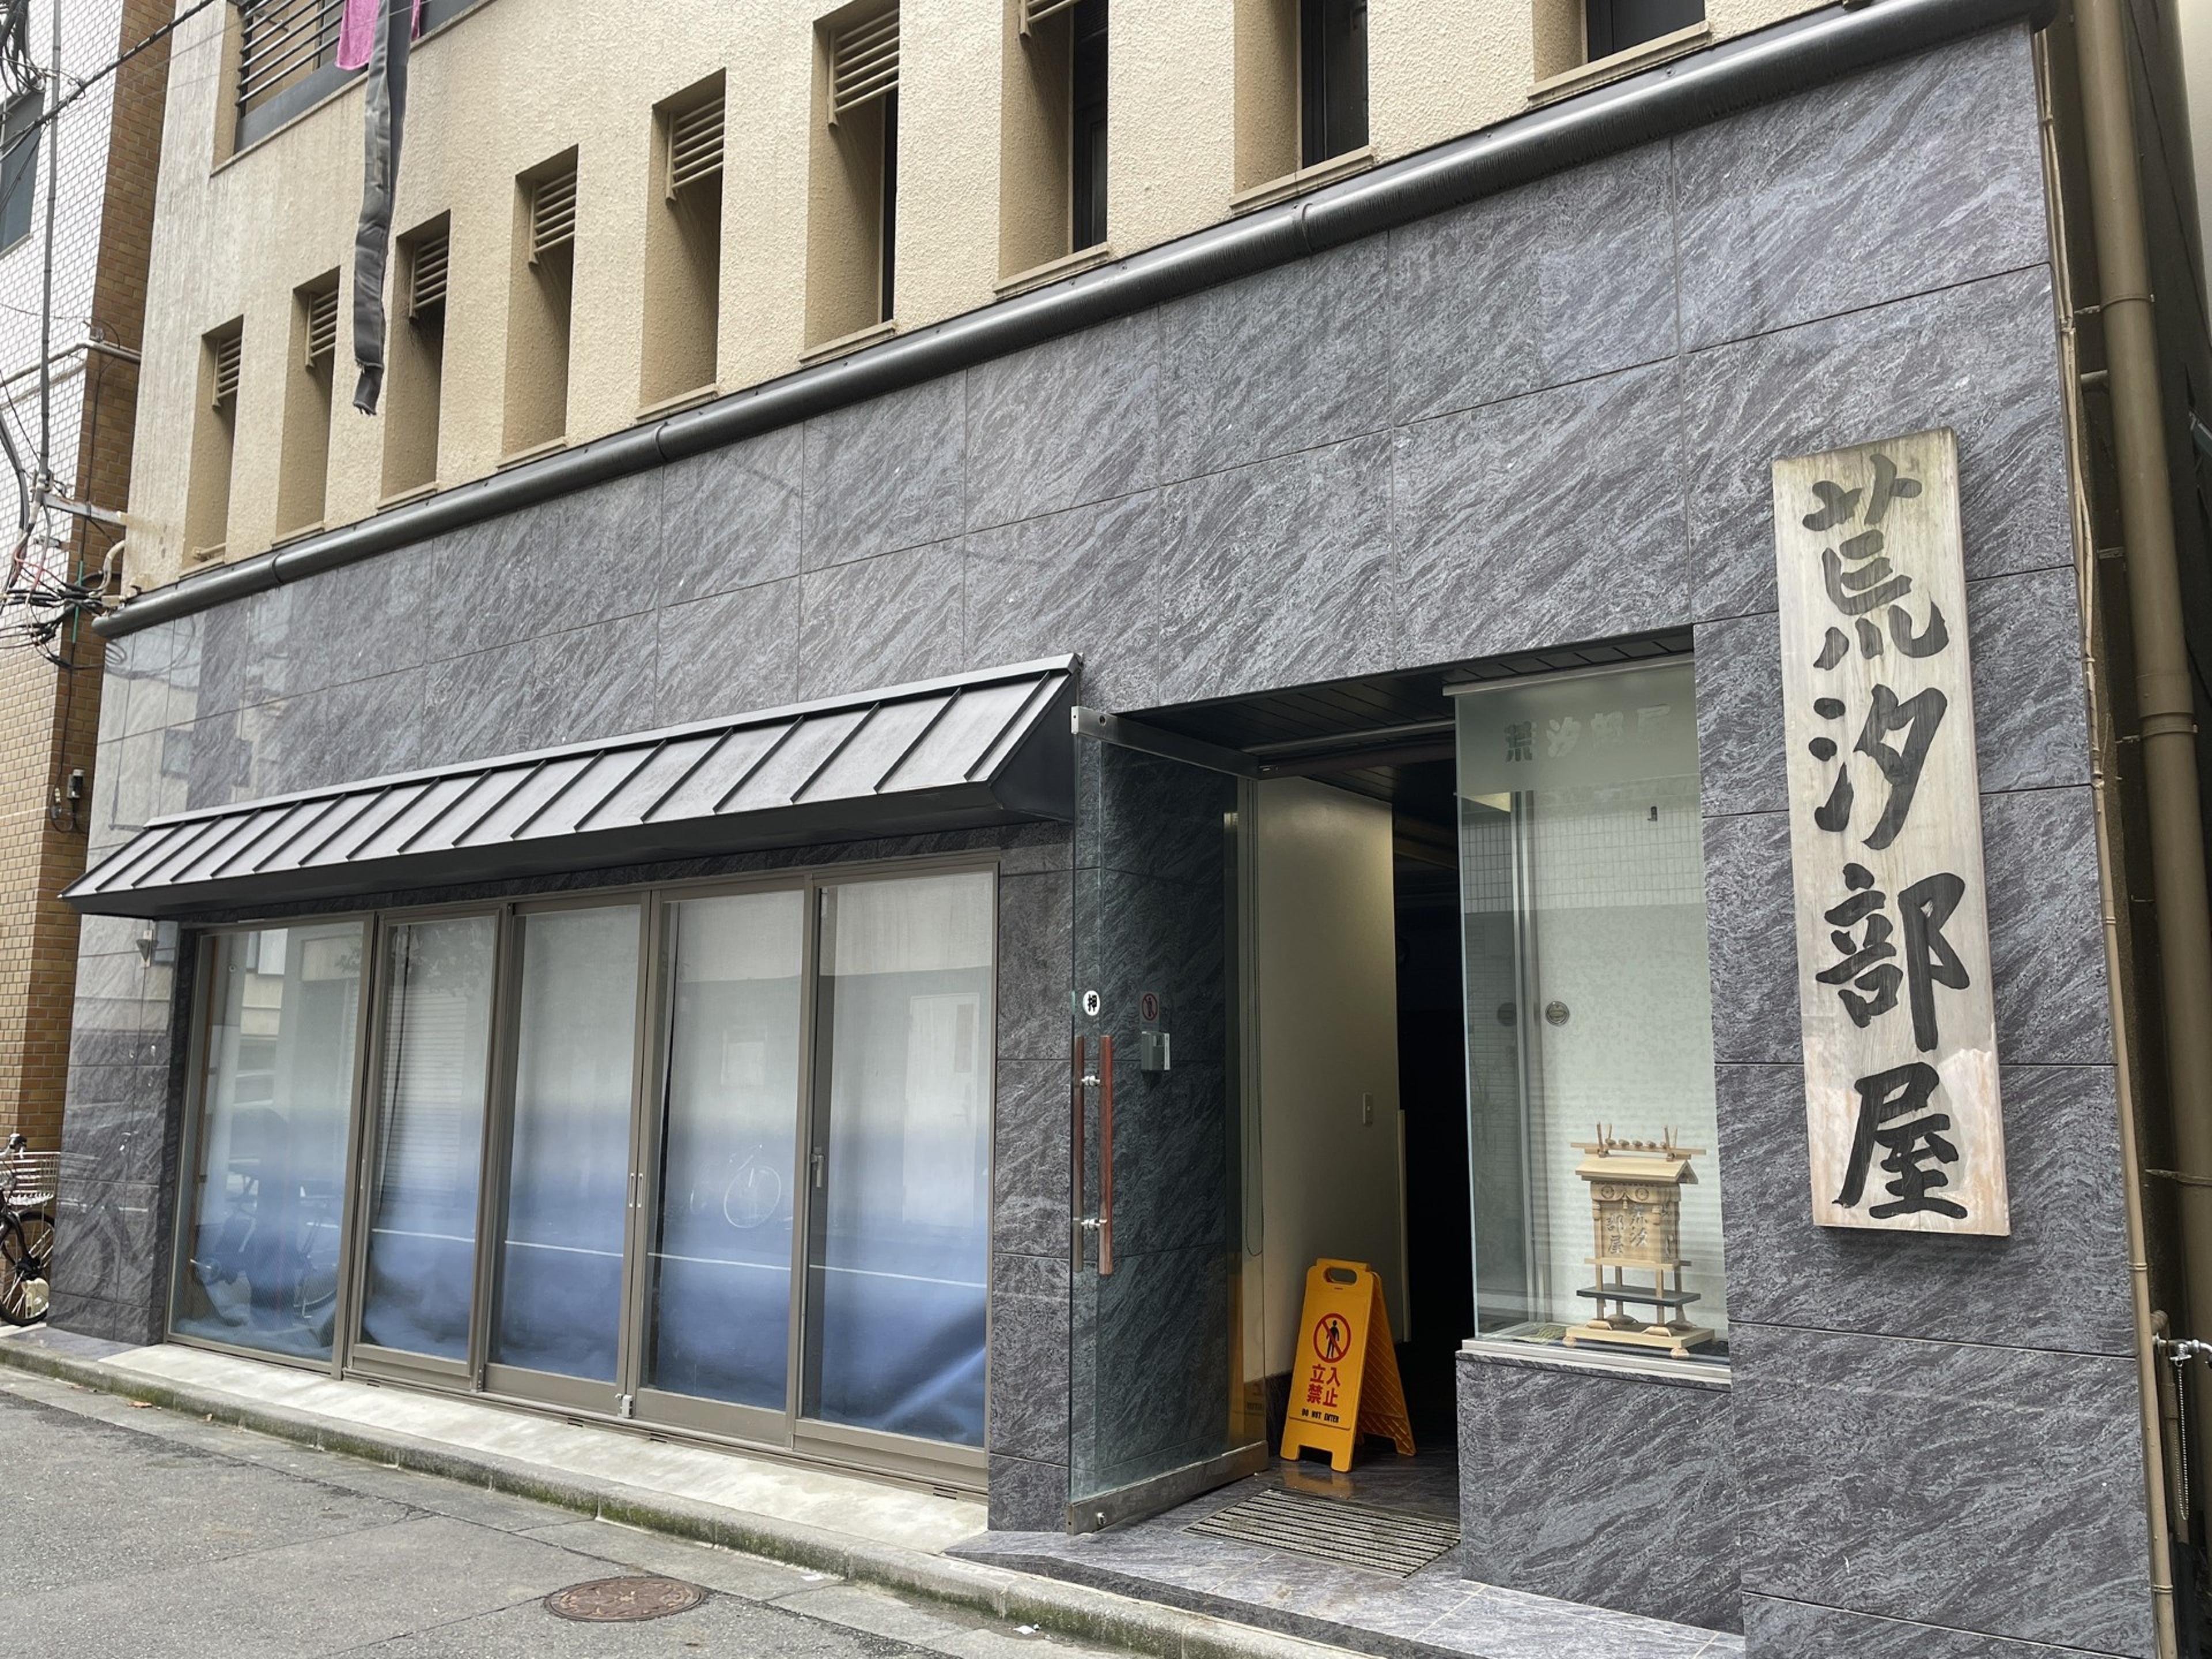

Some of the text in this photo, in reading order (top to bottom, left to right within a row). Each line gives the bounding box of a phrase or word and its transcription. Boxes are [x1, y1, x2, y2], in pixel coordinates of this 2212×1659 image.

[1802, 453, 1969, 1221] 荒汐部屋
[1309, 1363, 1341, 1387] 立入
[1306, 1384, 1338, 1407] 禁止
[1301, 1407, 1340, 1423] DO NOT ENTER
